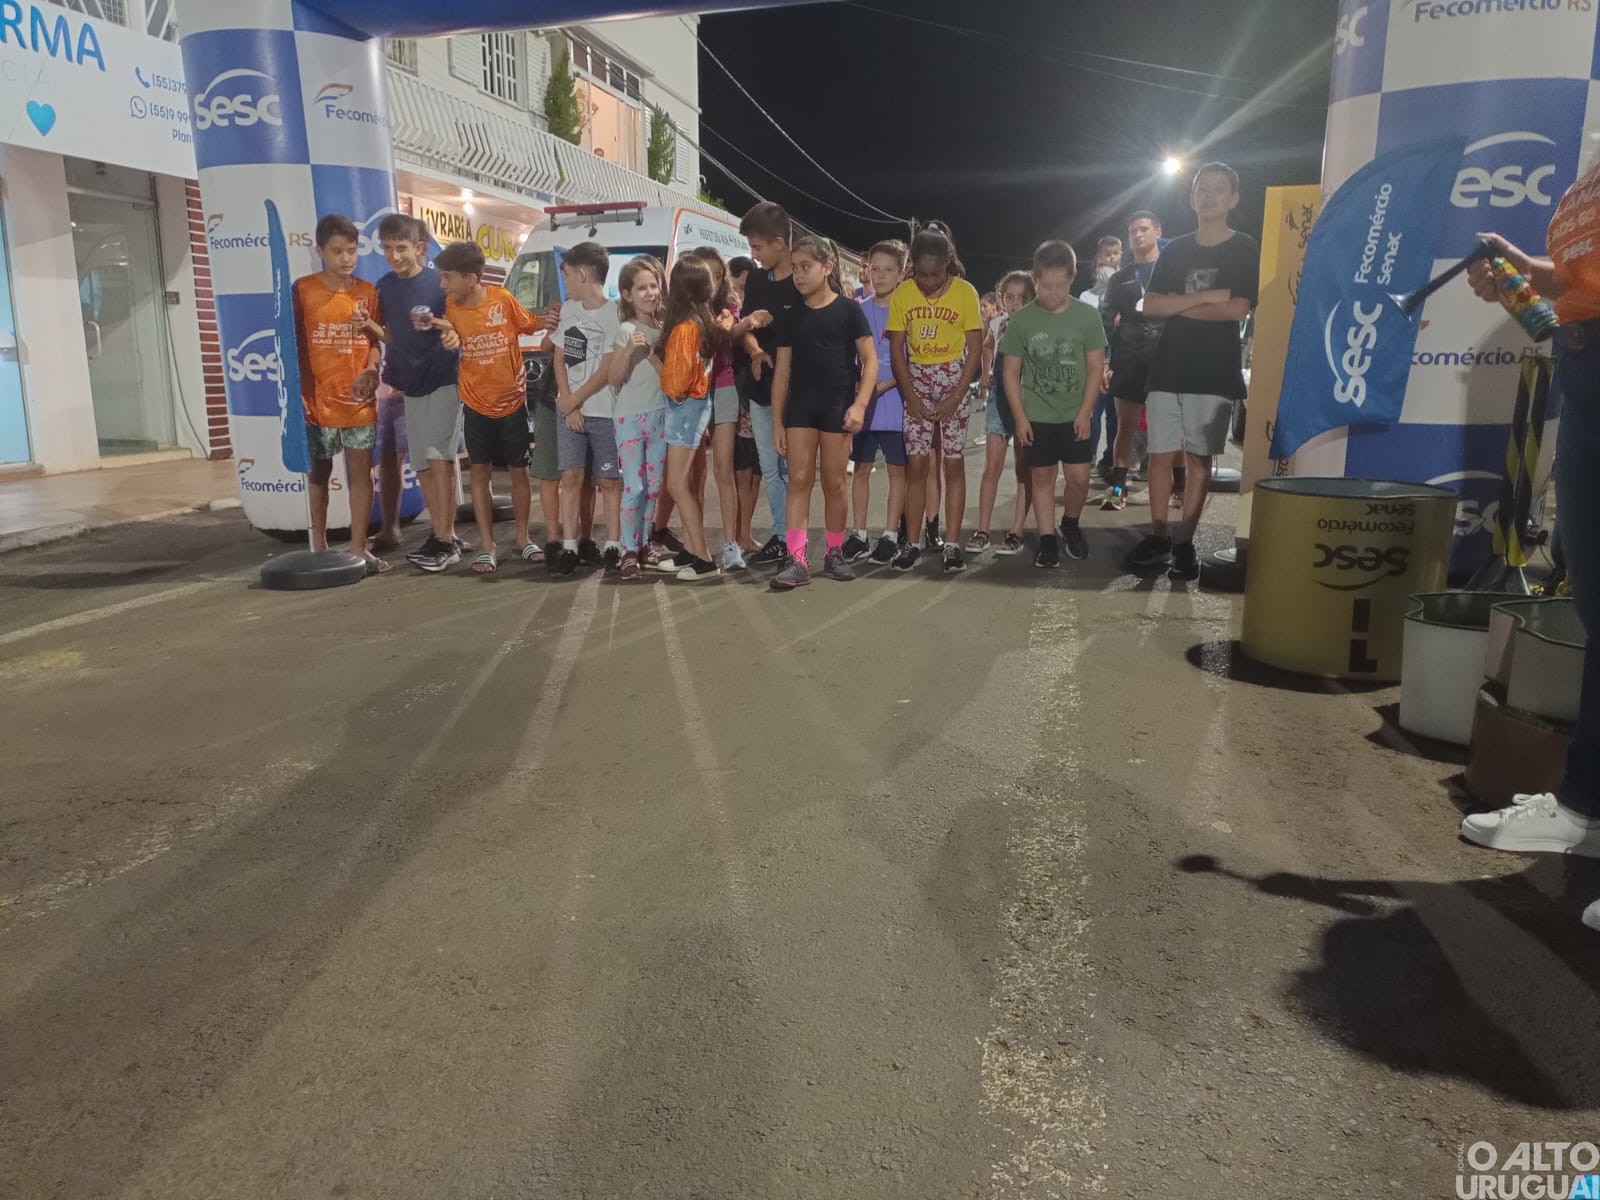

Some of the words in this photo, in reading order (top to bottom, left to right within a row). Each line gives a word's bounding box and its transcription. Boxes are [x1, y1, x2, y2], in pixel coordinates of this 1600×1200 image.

[1450, 164, 1556, 208] esc
[210, 233, 271, 249] Fecomérci
[289, 232, 313, 247] RS
[1354, 183, 1393, 284] Fecomércio
[1377, 231, 1402, 285] Senac
[919, 323, 938, 339] 94
[227, 347, 280, 382] Ses
[1411, 346, 1506, 366] comércio
